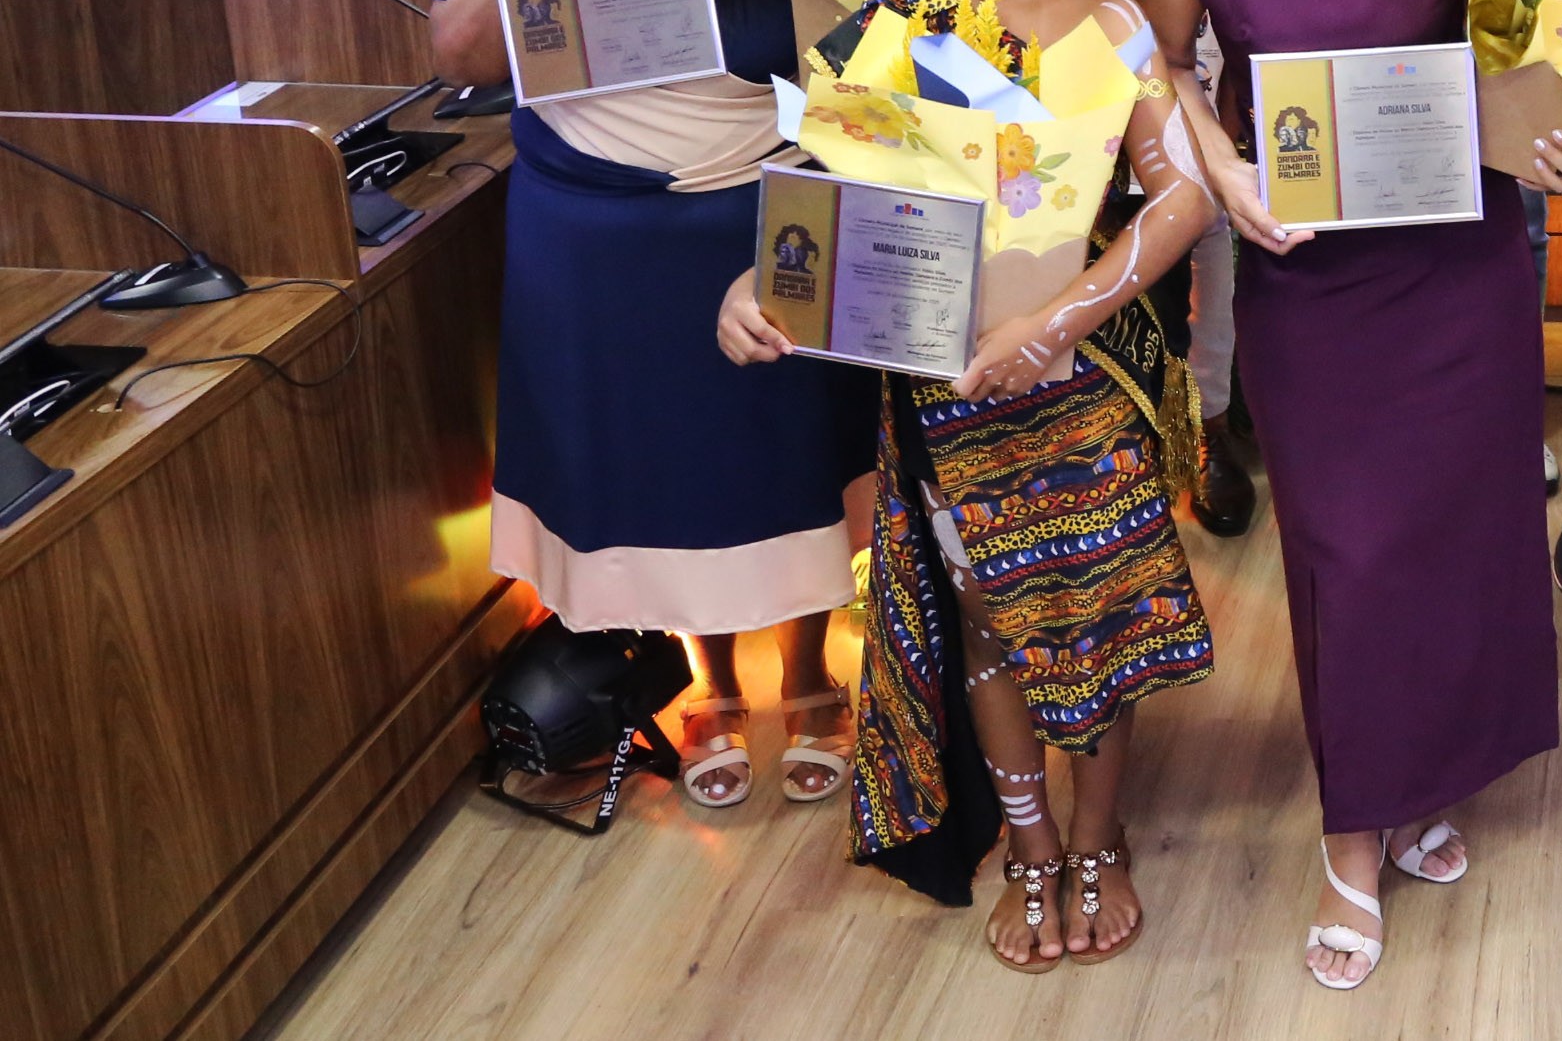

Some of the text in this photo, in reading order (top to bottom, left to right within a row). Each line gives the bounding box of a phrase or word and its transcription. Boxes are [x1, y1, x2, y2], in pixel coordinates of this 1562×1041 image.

[1378, 103, 1431, 116] ADRIANA SILVA
[873, 242, 940, 262] MARIA LUIZA SILVA
